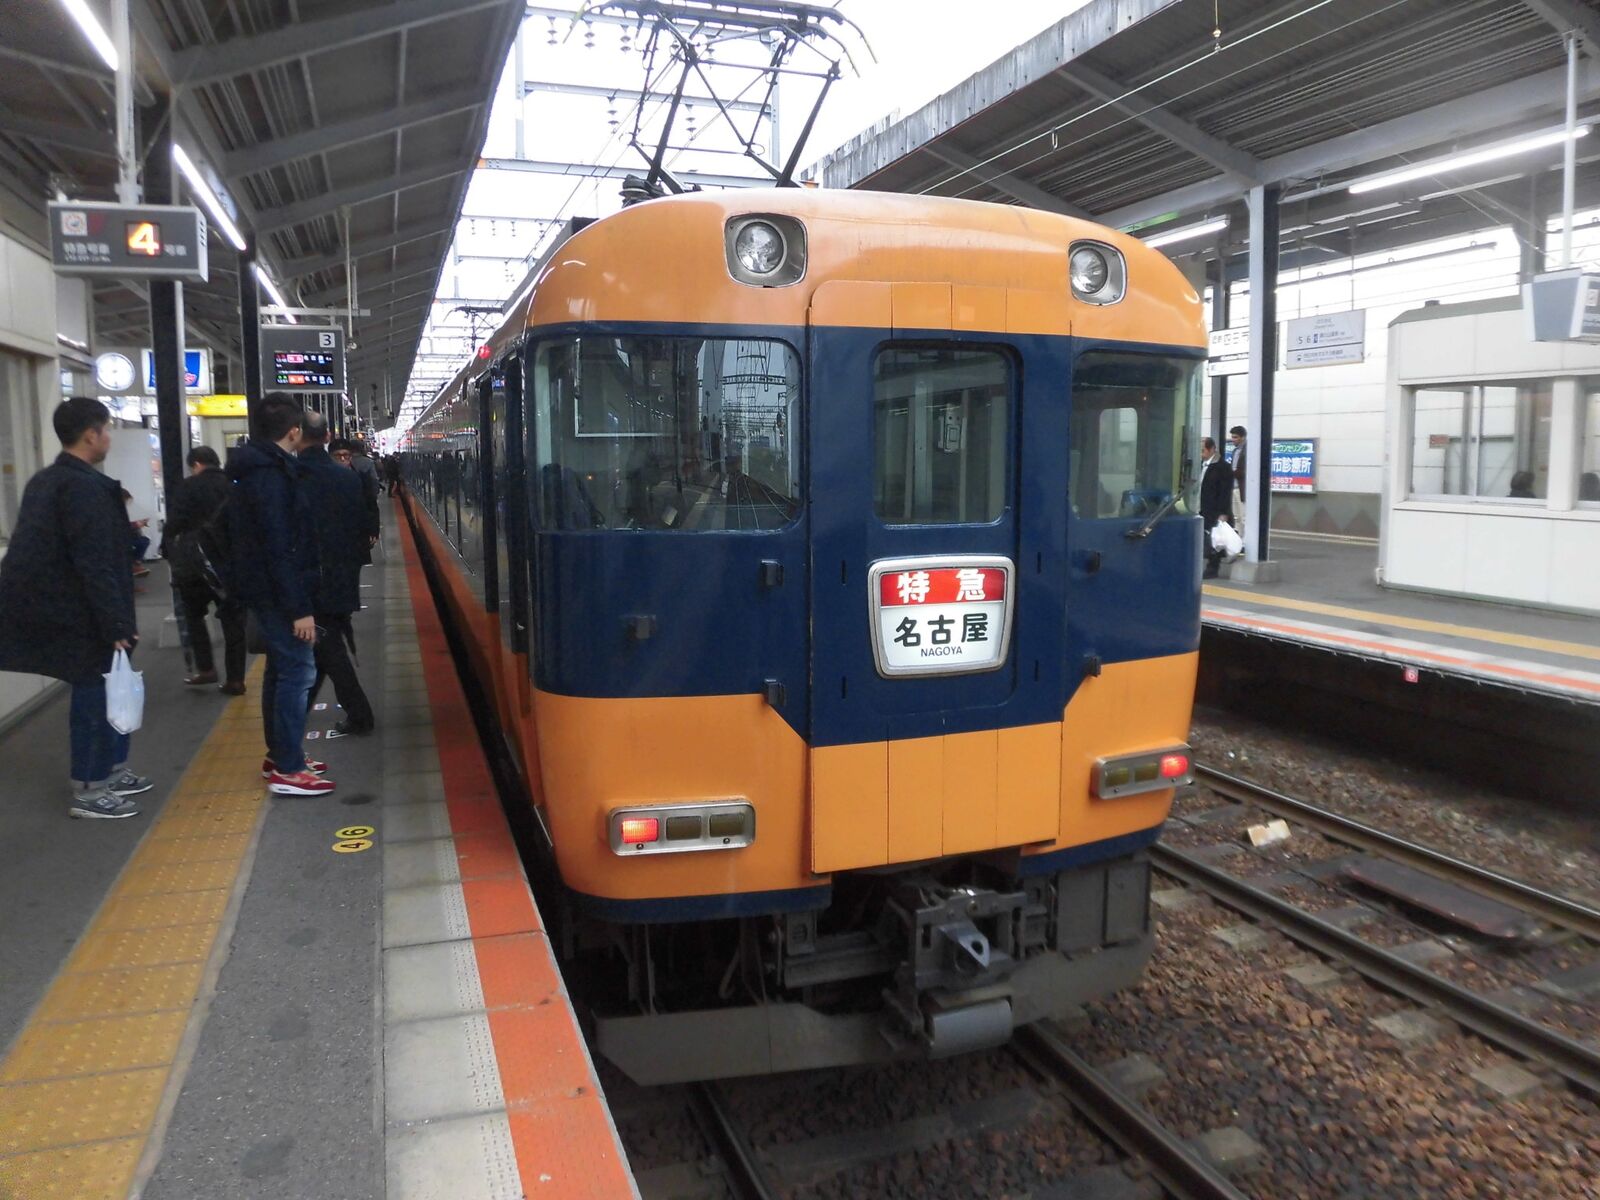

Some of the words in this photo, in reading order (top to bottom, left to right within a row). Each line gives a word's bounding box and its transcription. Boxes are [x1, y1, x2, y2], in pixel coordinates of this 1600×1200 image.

[128, 222, 160, 256] 4
[322, 334, 332, 346] 3
[897, 568, 986, 604] 特急
[893, 612, 988, 648] 名古屋
[920, 646, 963, 657] NAGOYA
